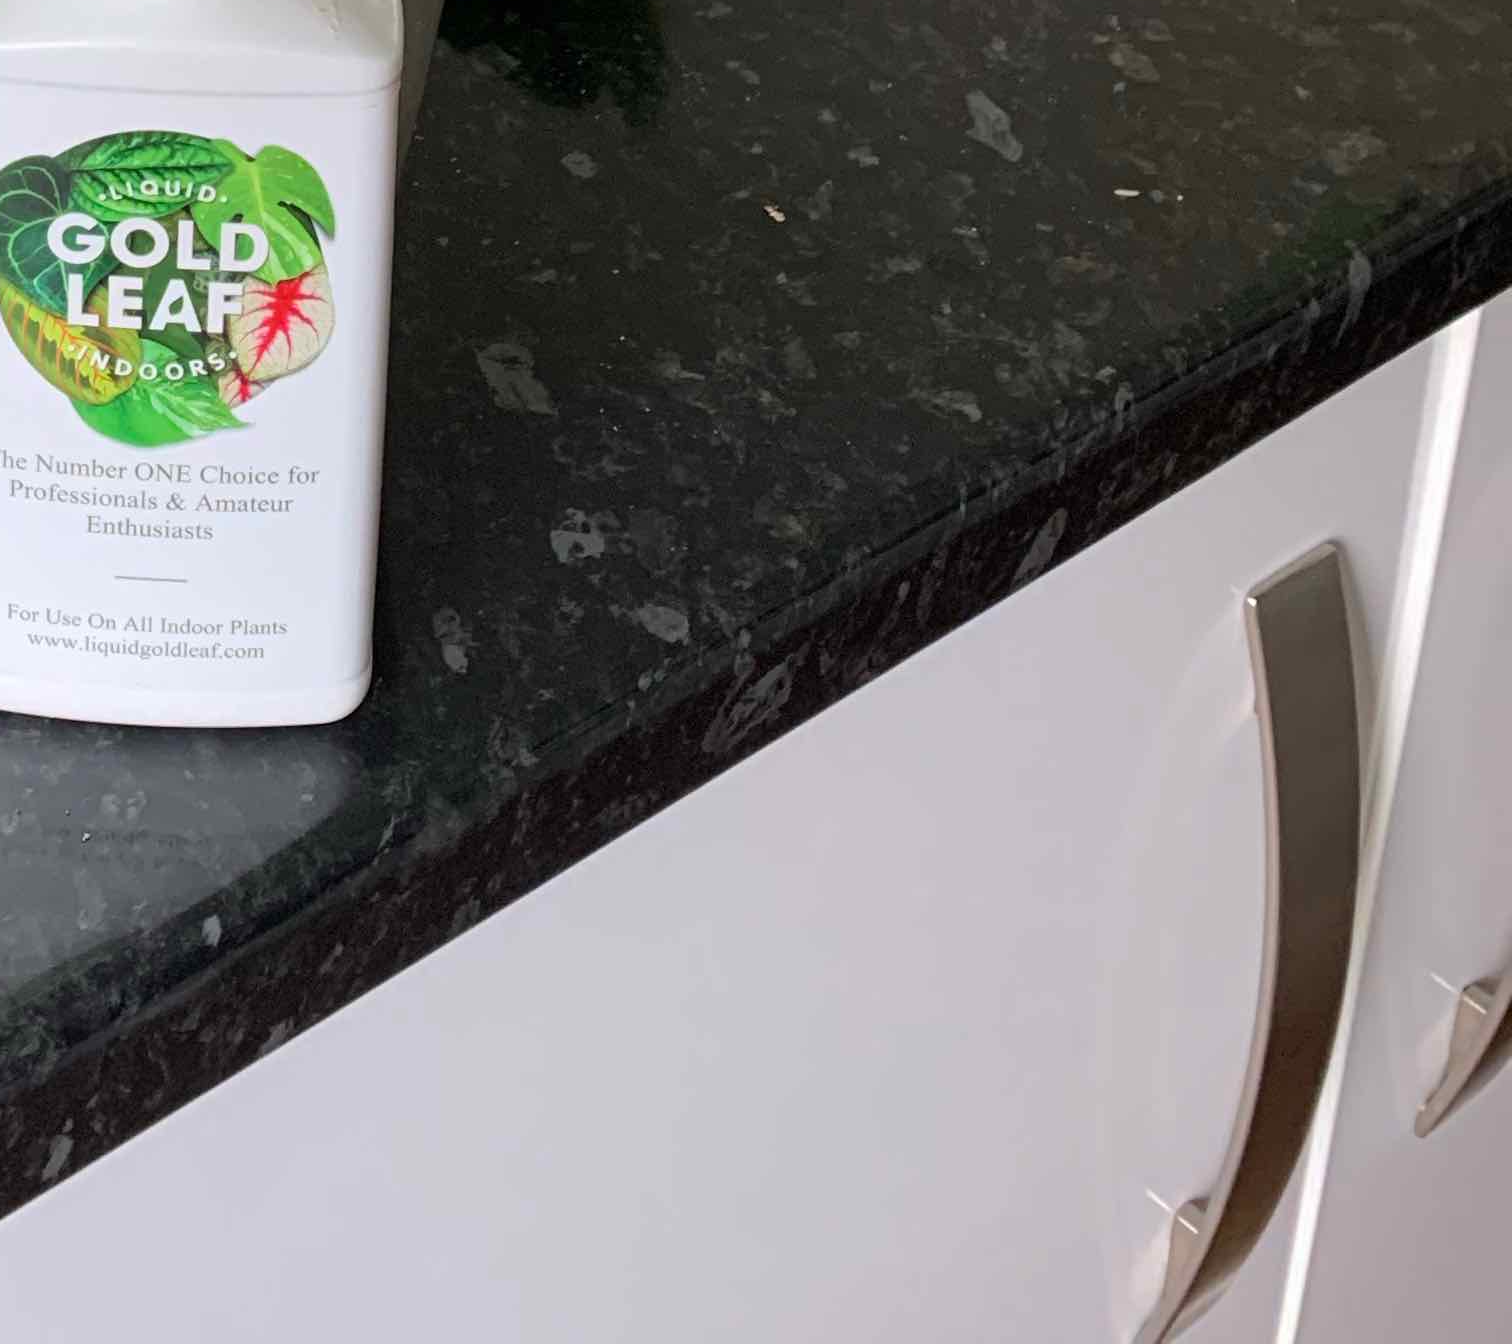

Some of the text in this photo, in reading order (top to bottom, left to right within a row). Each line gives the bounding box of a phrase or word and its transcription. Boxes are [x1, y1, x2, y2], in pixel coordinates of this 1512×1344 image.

[109, 179, 217, 203] LIQUID
[46, 212, 270, 273] GOLD
[65, 273, 244, 334] LEAF
[76, 341, 226, 381] INDOORS
[34, 453, 128, 480] Number
[134, 462, 192, 484] ONE
[199, 464, 280, 485] Choice
[287, 465, 320, 485] for
[8, 479, 294, 513] Professionals & Amateur
[86, 514, 214, 541] Enthusiasts
[7, 603, 289, 636] For Use On All Indoor Plants
[27, 632, 265, 659] www.liquidgoldleaf.com
